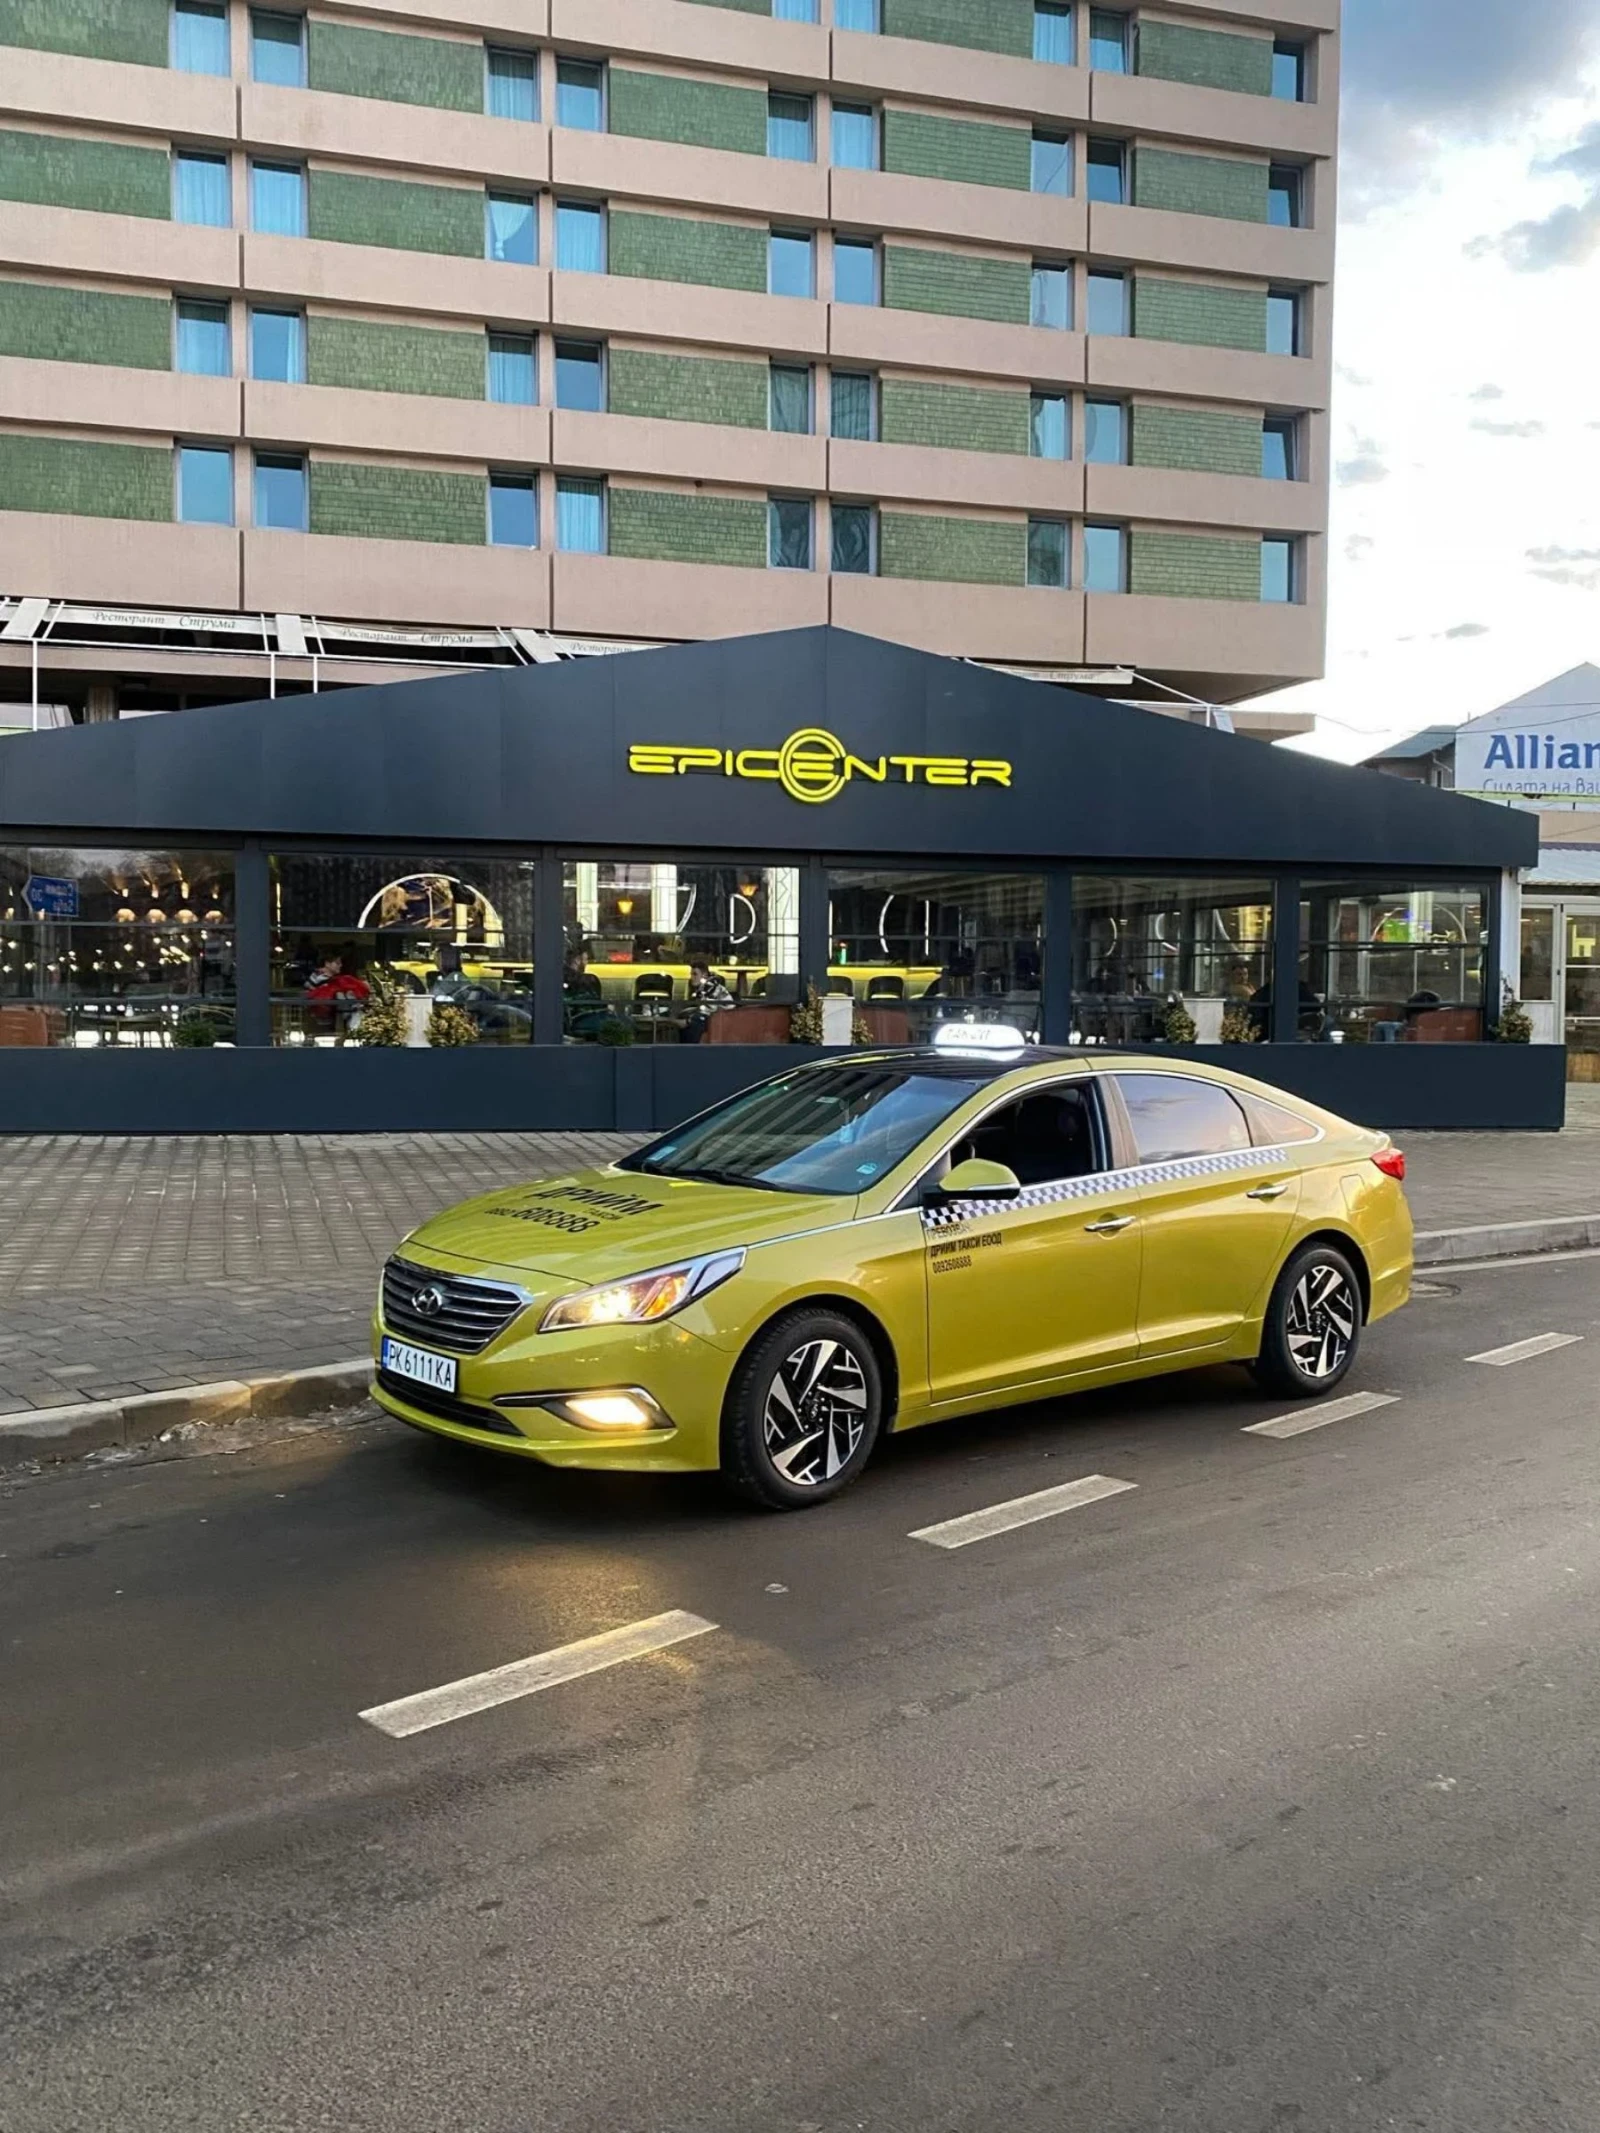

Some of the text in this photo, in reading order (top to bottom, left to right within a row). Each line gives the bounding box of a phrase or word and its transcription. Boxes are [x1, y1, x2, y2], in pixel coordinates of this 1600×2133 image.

[94, 611, 236, 630] Ресторант Струма
[421, 632, 473, 647] Струма
[629, 728, 1012, 803] EPICENTER
[1483, 778, 1547, 793] Силата
[1552, 782, 1571, 793] на
[958, 1235, 980, 1251] ТАКСИ
